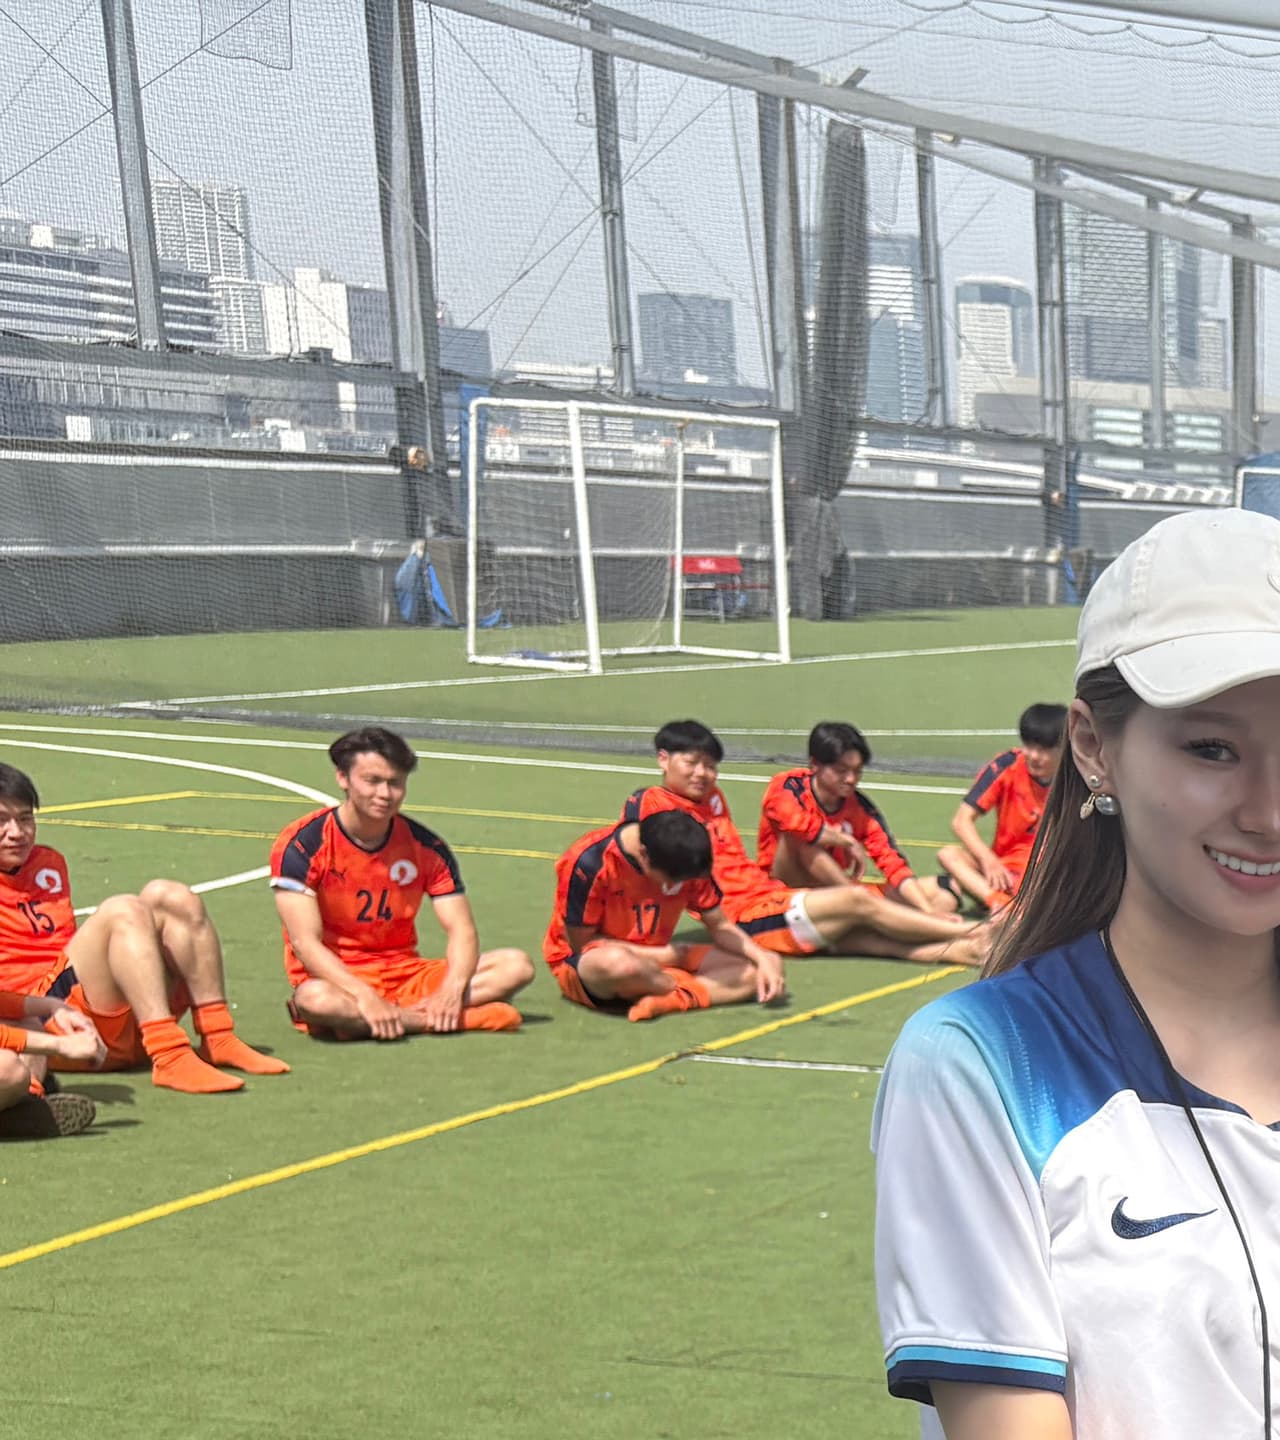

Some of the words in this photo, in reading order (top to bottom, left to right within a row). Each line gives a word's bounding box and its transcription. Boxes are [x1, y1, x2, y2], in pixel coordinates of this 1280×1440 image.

[17, 901, 55, 934] 15
[356, 889, 393, 922] 24
[632, 903, 661, 935] 17
